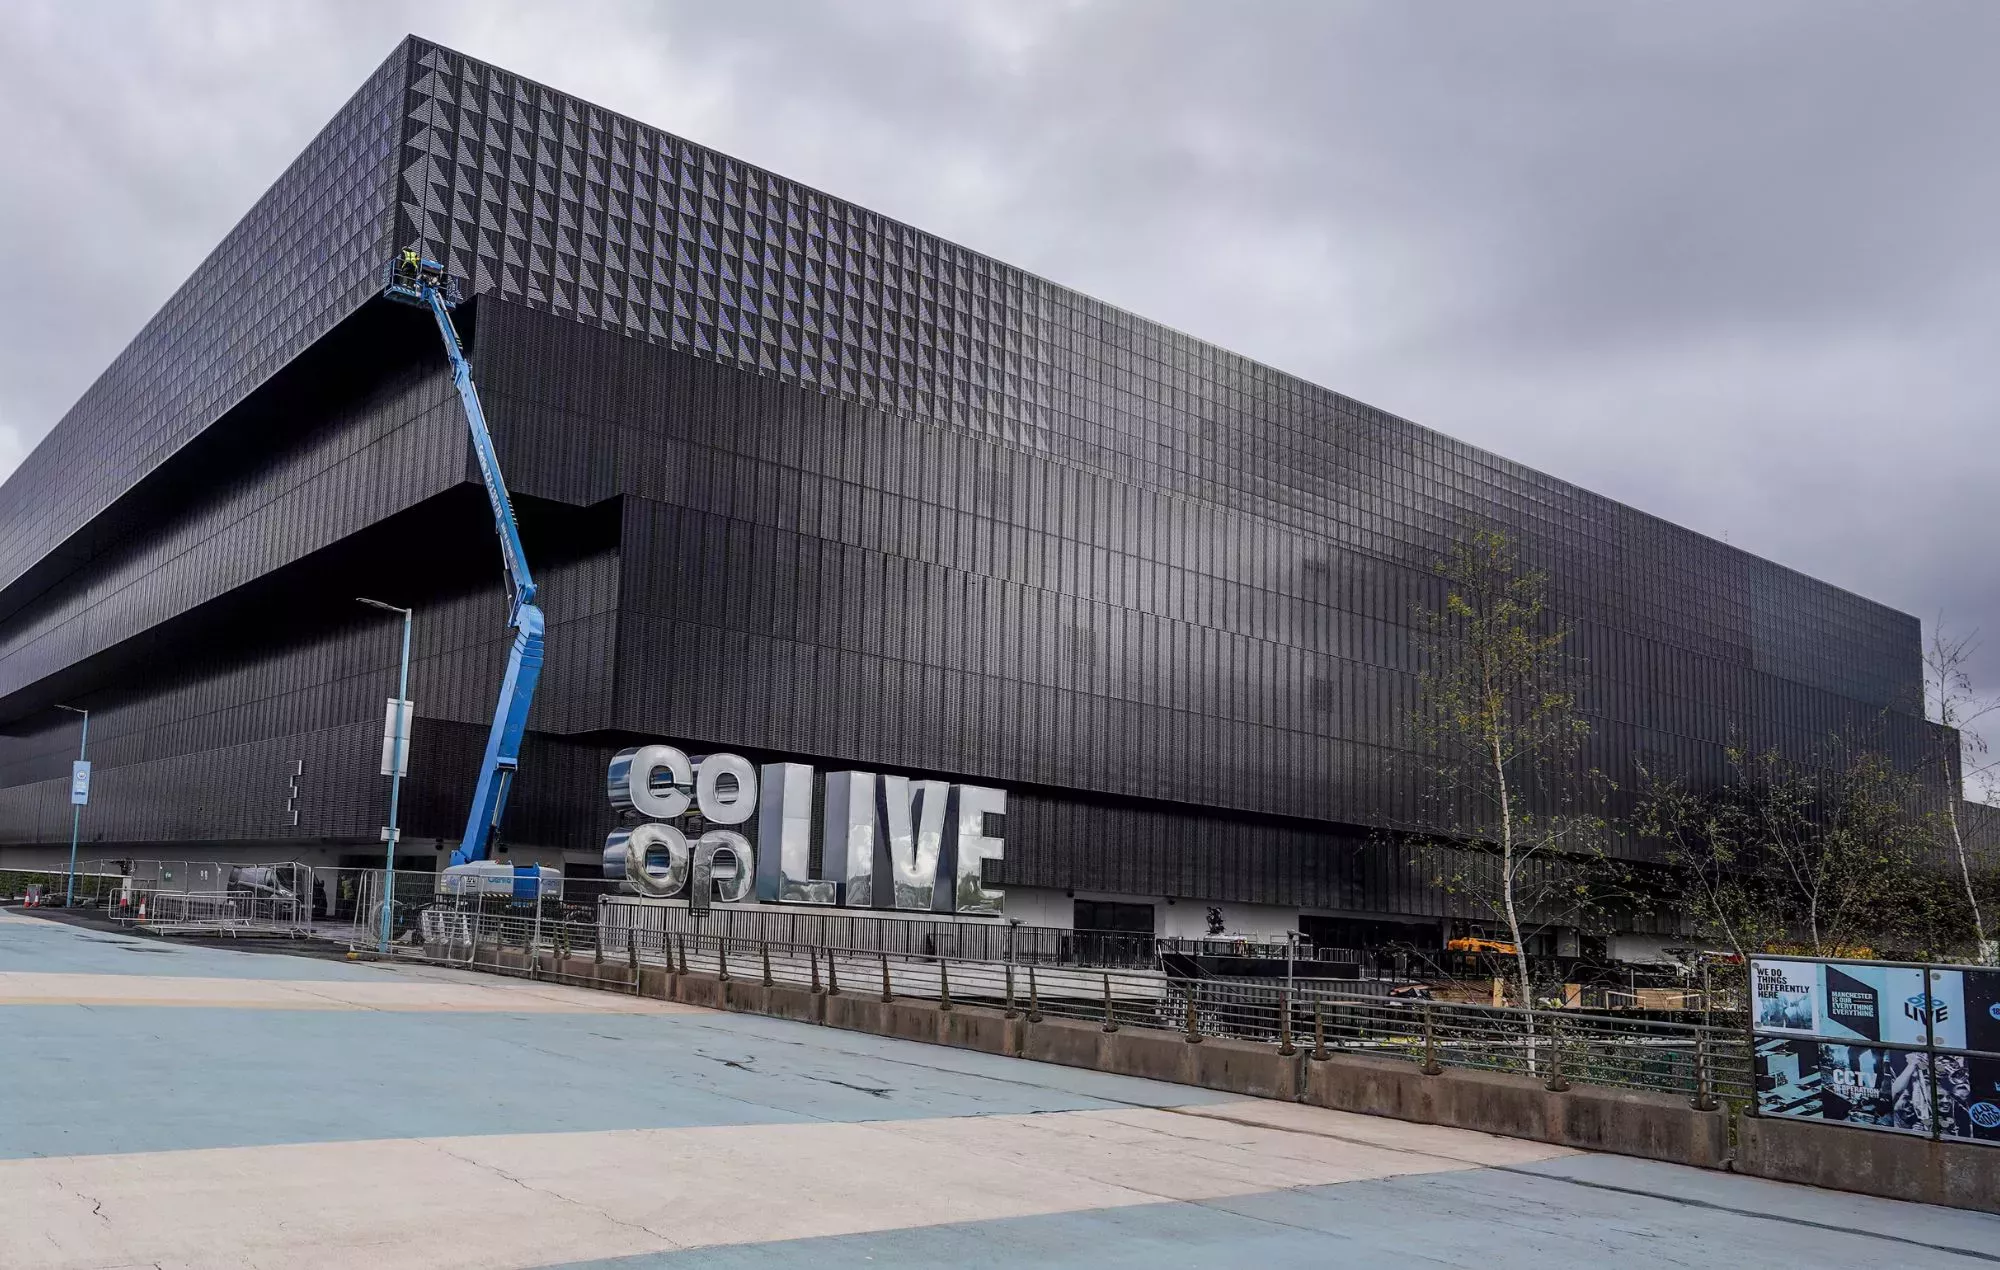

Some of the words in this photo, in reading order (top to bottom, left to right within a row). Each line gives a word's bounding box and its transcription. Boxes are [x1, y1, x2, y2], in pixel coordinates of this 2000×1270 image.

[757, 762, 1008, 915] LIVE
[1757, 968, 1769, 976] WE
[1771, 969, 1782, 977] DO
[1757, 976, 1788, 985] THINGS
[1758, 984, 1810, 994] DIFFERENTLY
[1758, 991, 1779, 999] HERE
[1831, 992, 1873, 1000] MANCHESTER
[1832, 1003, 1874, 1011] EVERYTHING
[1832, 1009, 1874, 1017] EVERYTHING
[1904, 1002, 1948, 1025] LIVE
[1833, 1069, 1878, 1088] CCTV
